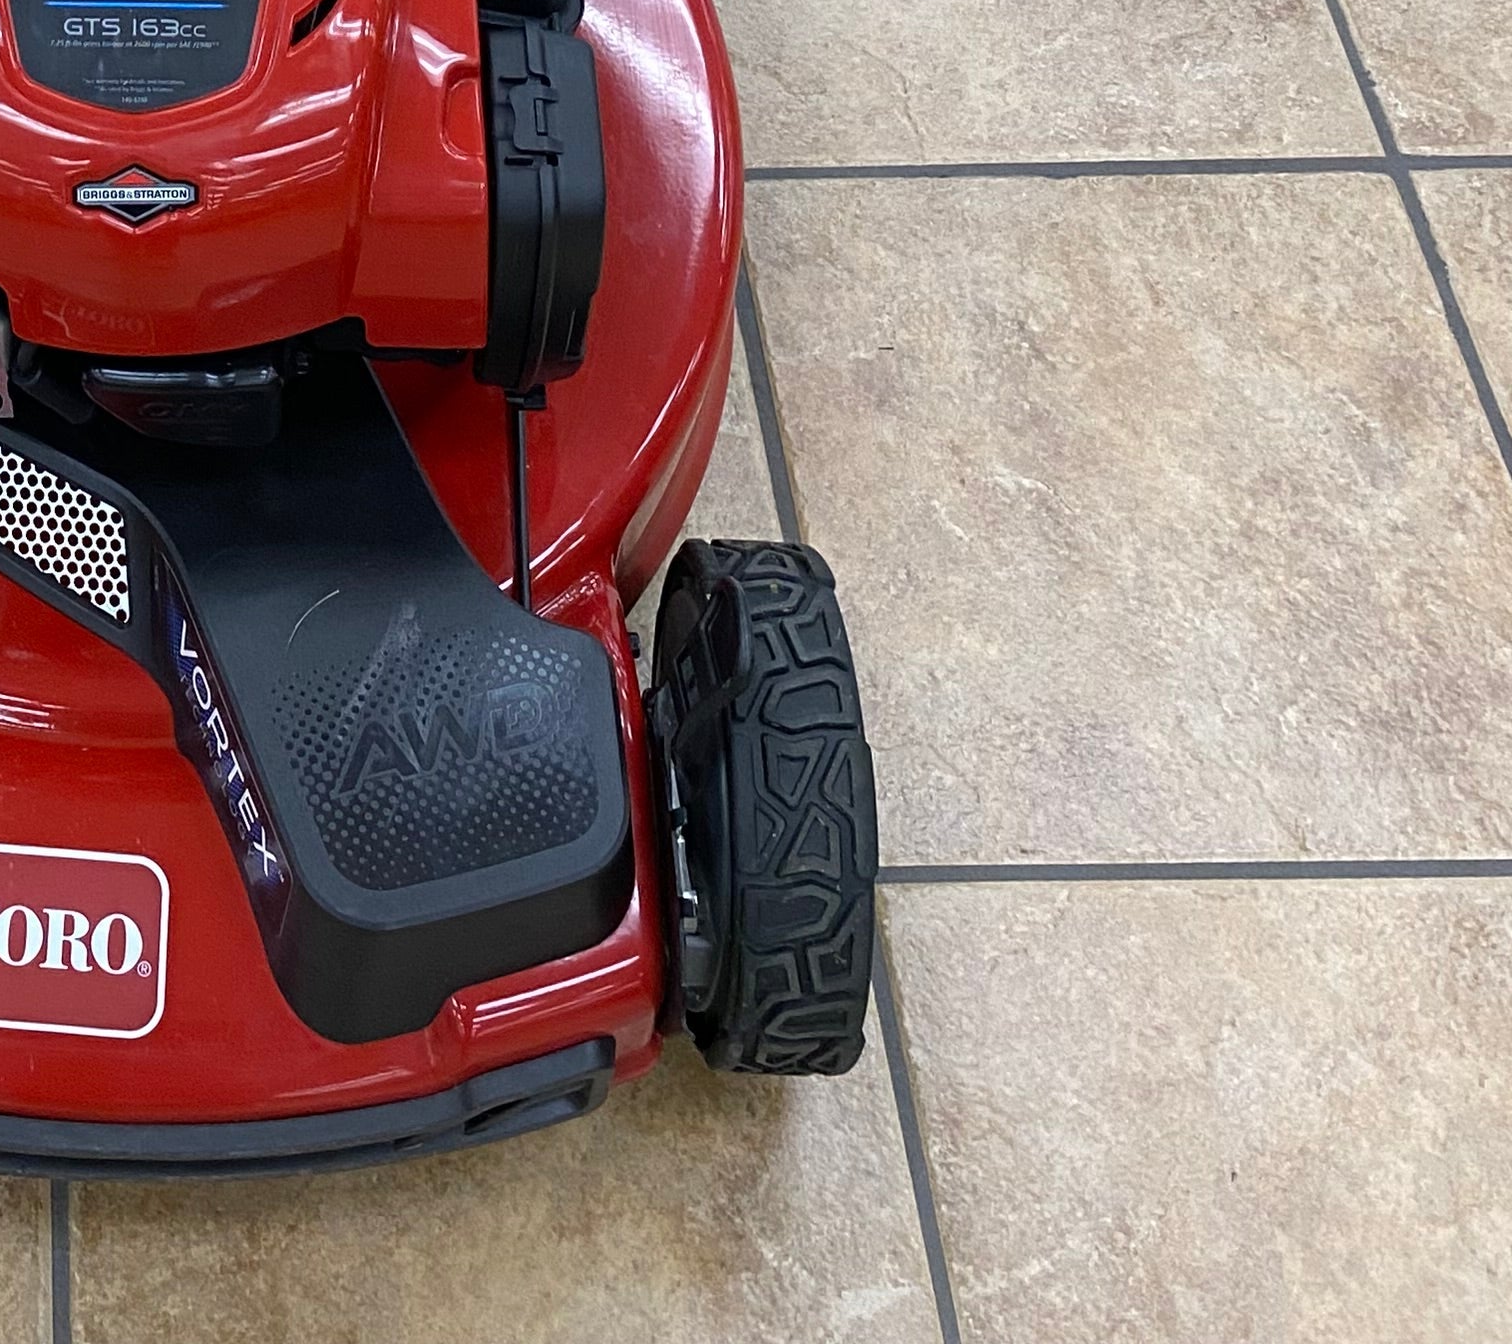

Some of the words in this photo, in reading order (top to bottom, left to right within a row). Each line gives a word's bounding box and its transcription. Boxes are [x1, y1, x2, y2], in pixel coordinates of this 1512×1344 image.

[63, 17, 121, 37] GTS
[131, 17, 207, 38] 163cc
[180, 619, 277, 876] VORTEX
[331, 682, 556, 799] AWD
